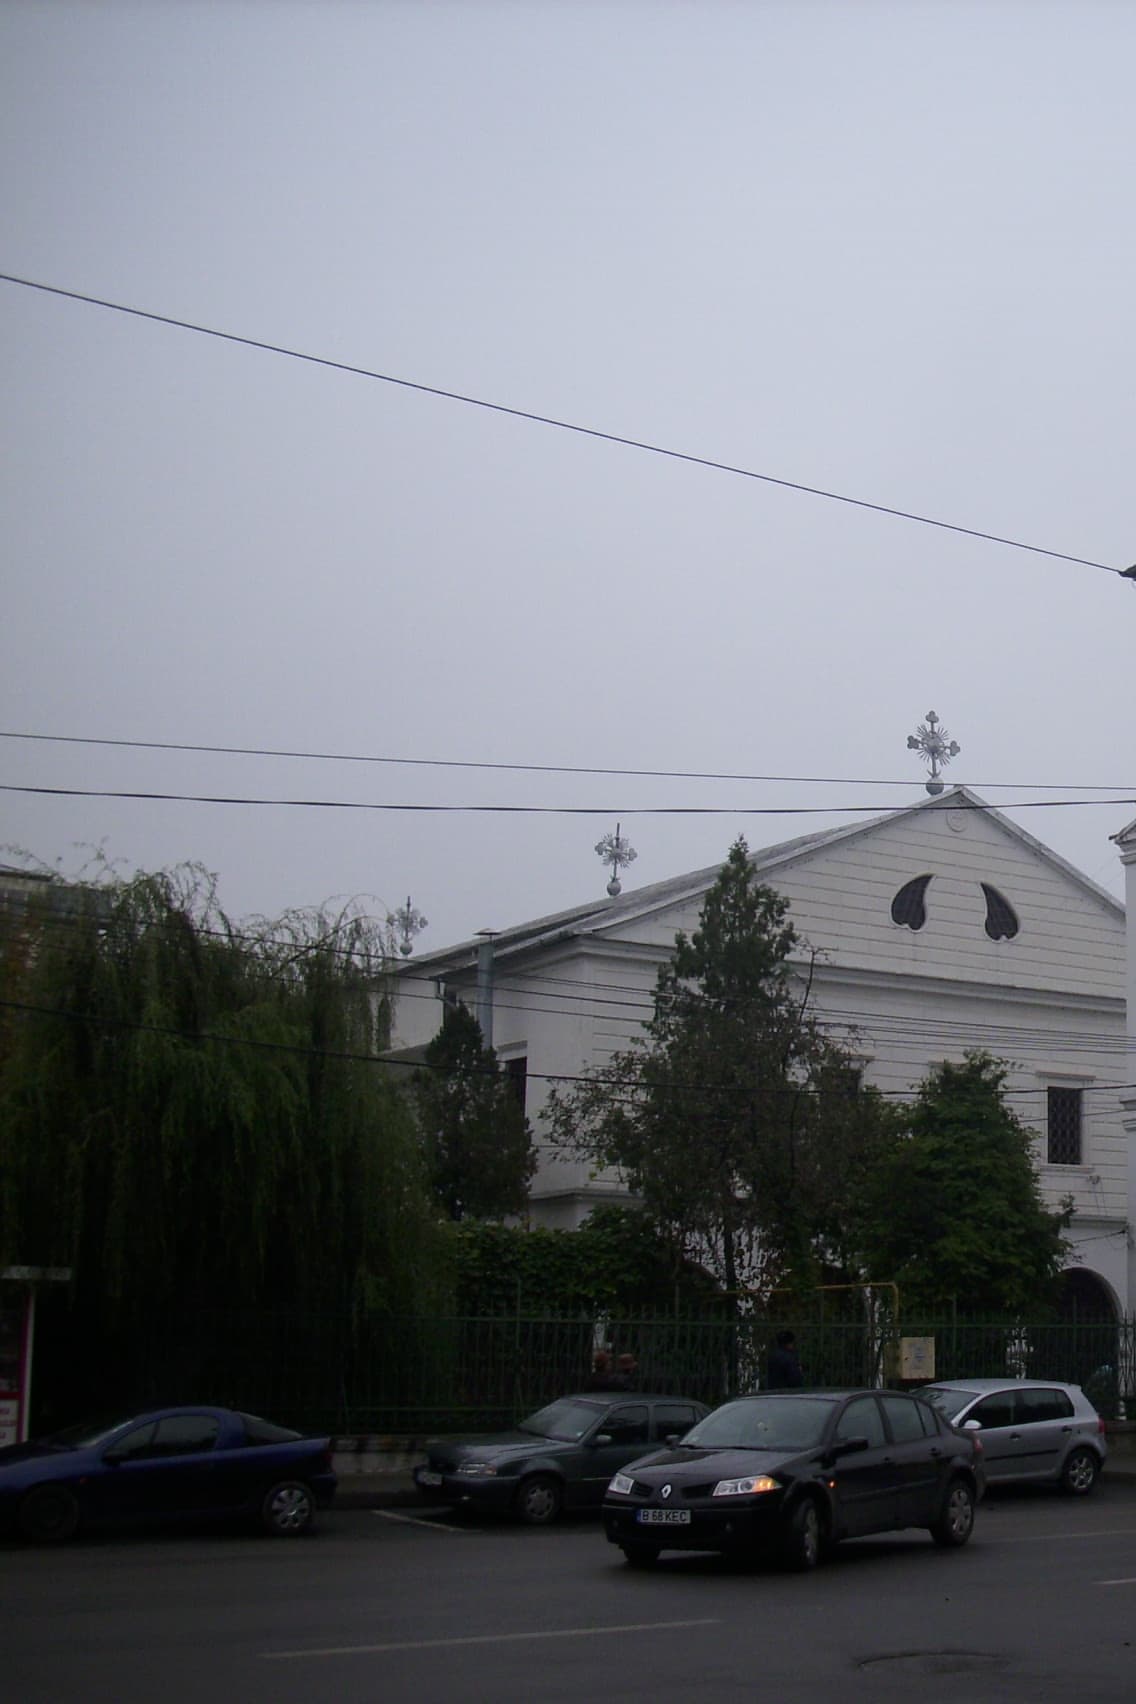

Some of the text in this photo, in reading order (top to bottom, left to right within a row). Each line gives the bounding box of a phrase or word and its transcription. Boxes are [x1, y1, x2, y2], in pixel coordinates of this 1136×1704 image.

[642, 1511, 687, 1521] B 68 KEC
